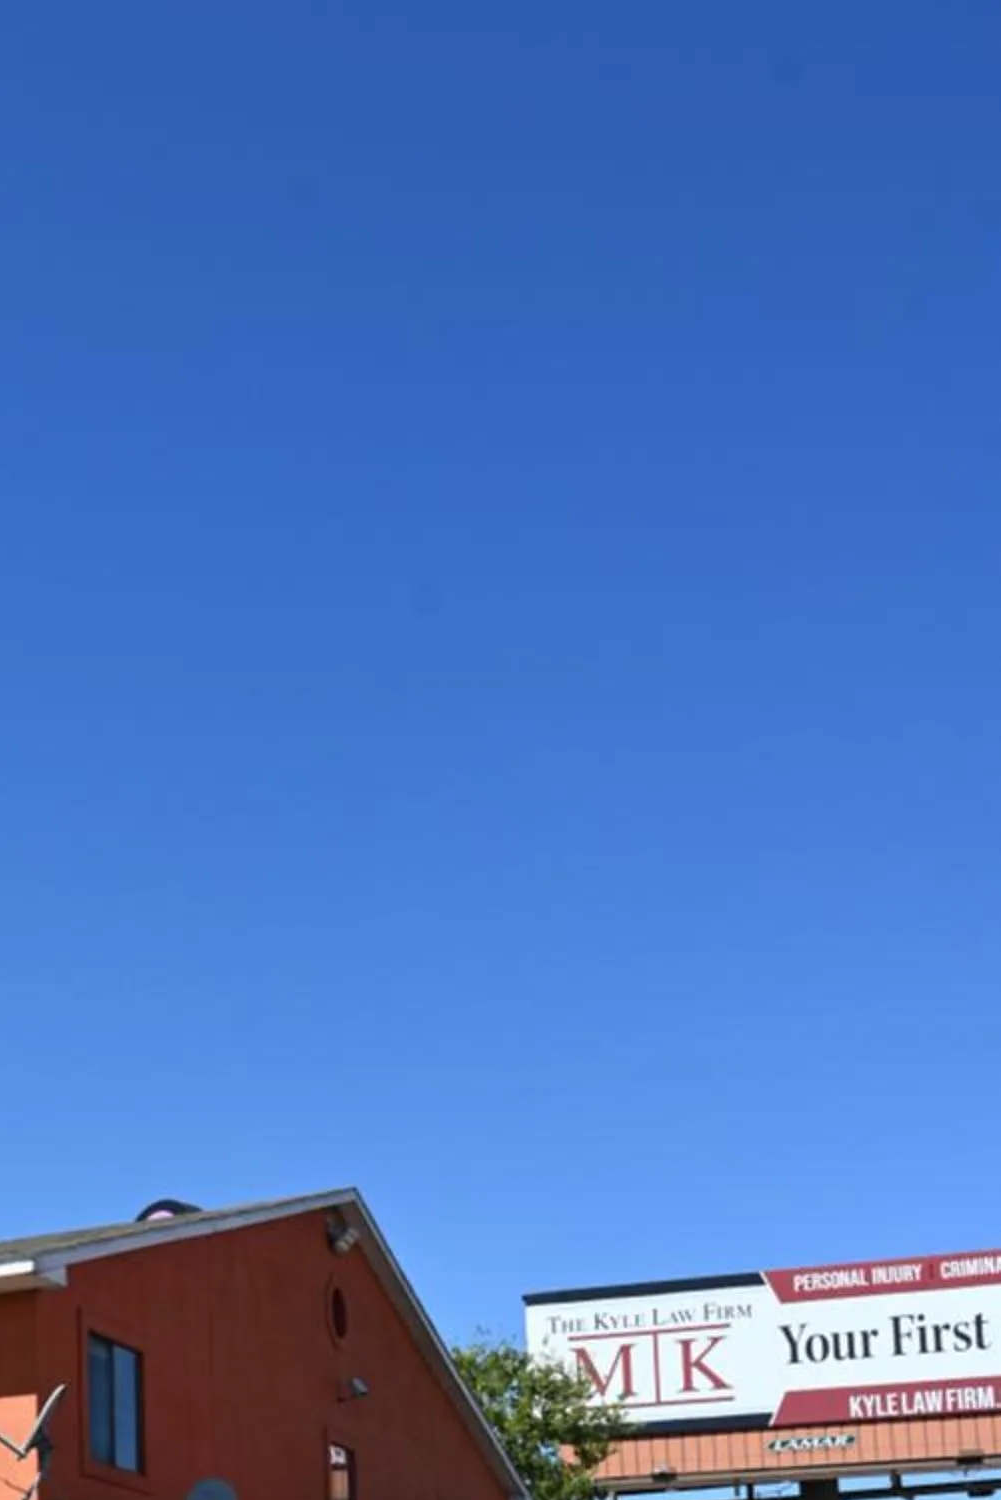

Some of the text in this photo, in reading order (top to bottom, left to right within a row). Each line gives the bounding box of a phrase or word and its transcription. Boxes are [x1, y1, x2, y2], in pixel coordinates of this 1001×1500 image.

[793, 1268, 870, 1293] PERSONAL
[871, 1263, 923, 1285] INJURY
[549, 1302, 753, 1334] THE KYLE LAW FIRM
[779, 1311, 992, 1365] Your First
[676, 1335, 734, 1393] K
